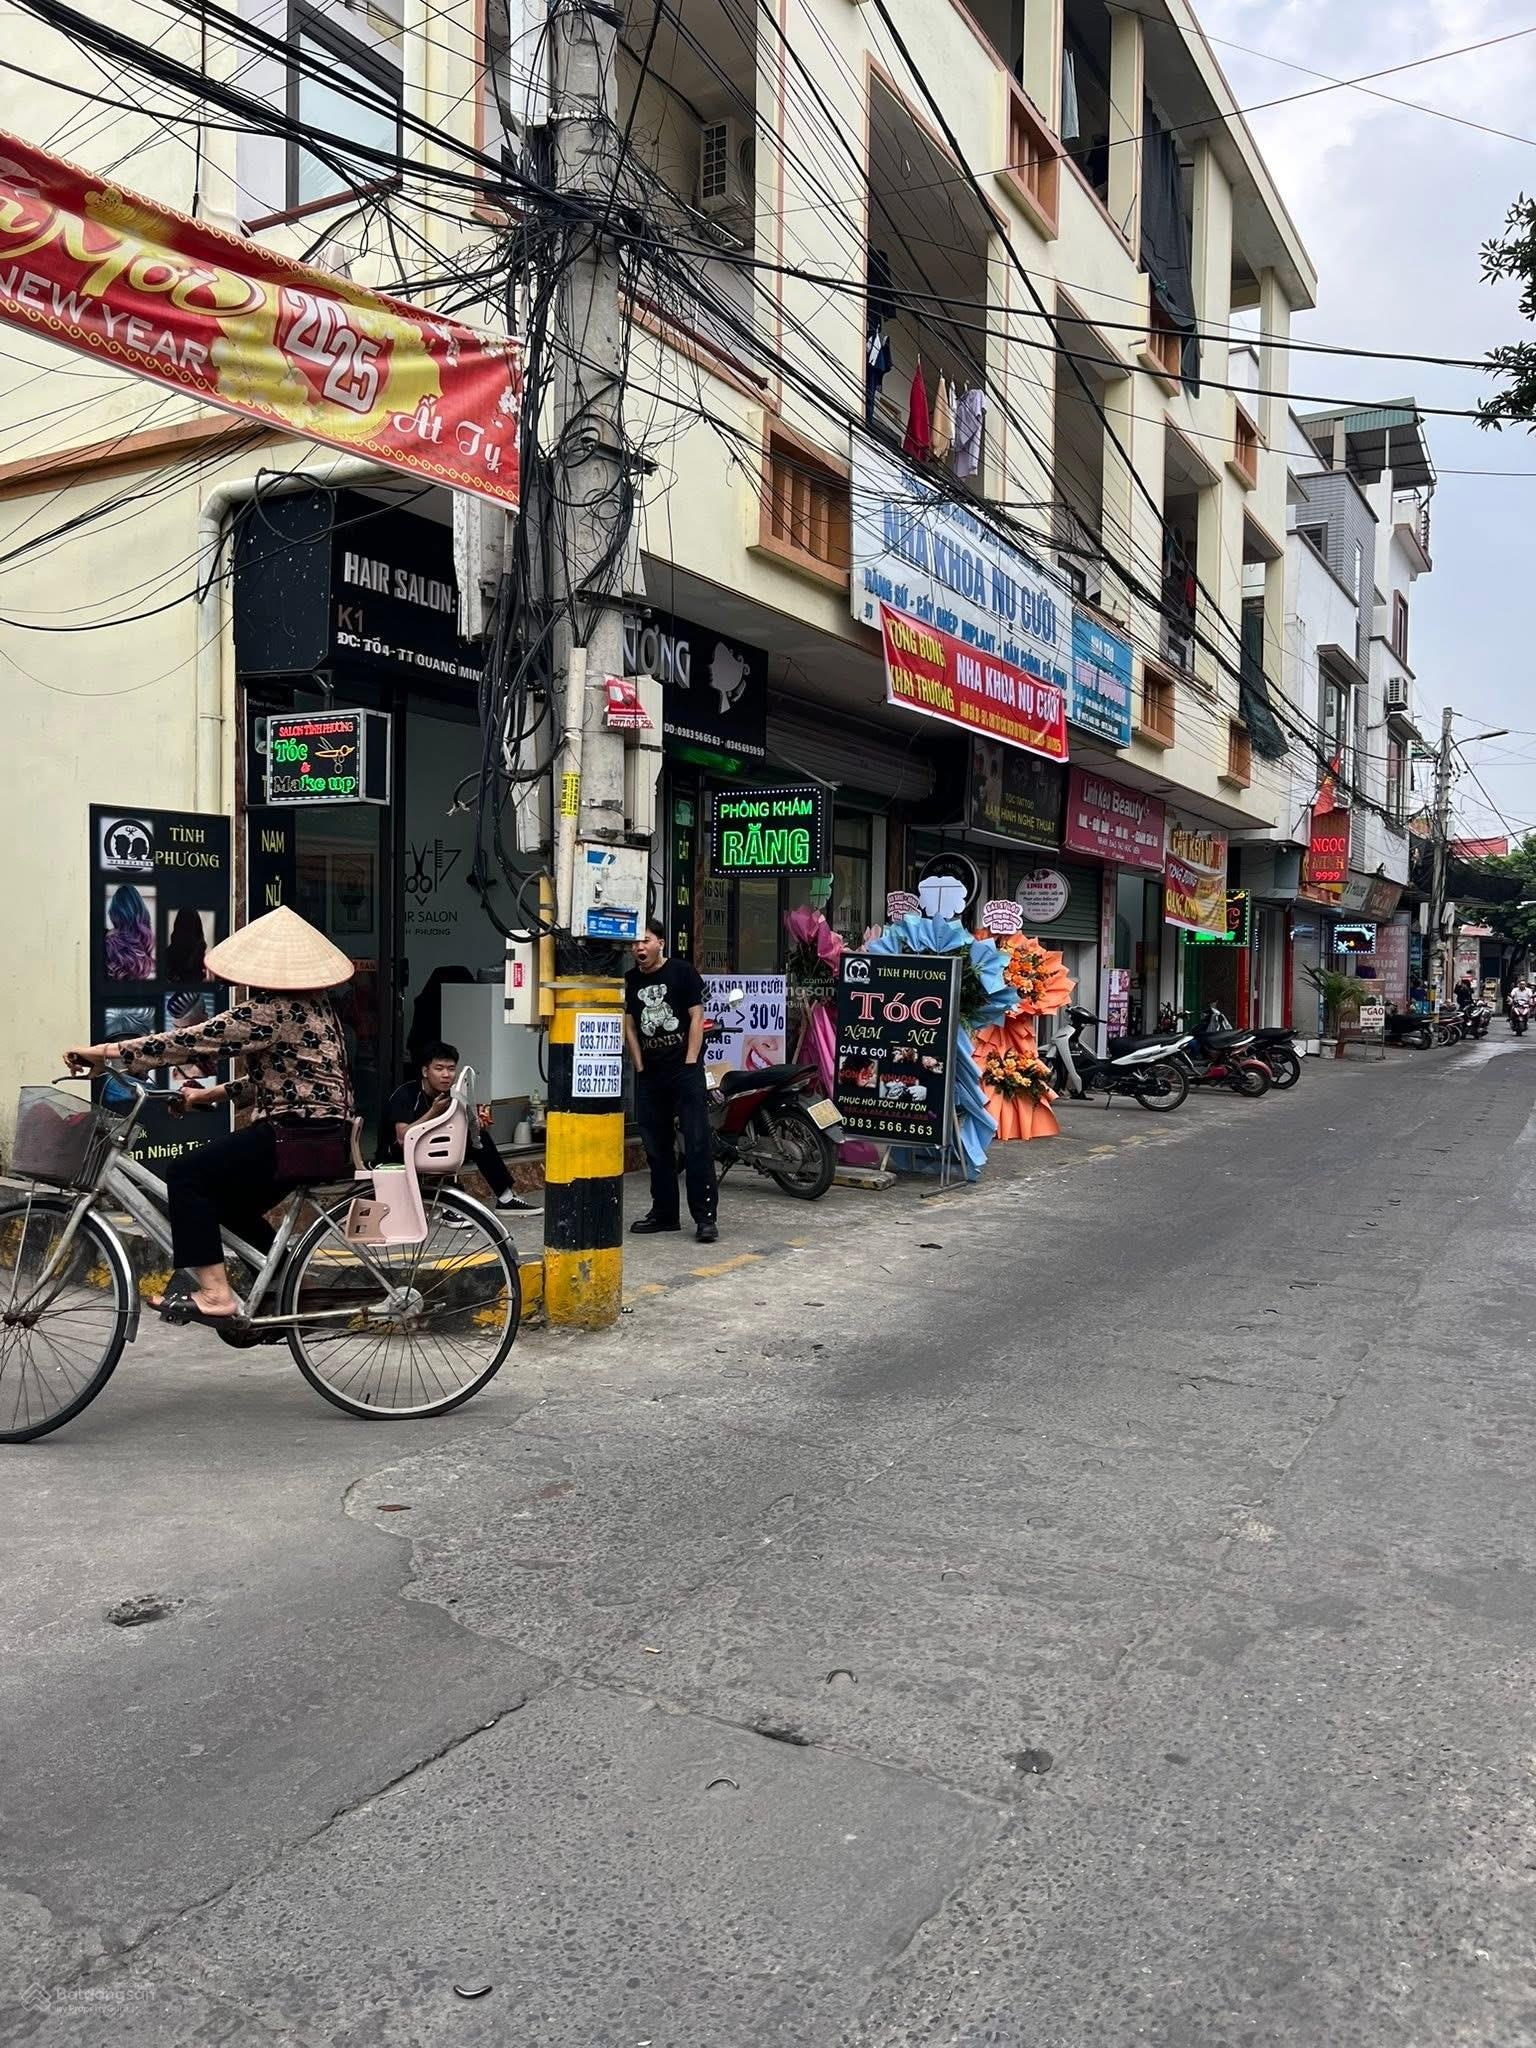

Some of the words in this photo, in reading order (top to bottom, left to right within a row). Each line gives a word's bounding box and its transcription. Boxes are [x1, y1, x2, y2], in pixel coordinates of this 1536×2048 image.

[102, 304, 208, 376] YEAR
[284, 287, 381, 412] 2025
[393, 395, 443, 444] Ất
[344, 551, 390, 594] HAIR
[934, 531, 985, 606] KHOA
[339, 604, 364, 633] K1
[415, 654, 456, 675] QUANG
[458, 666, 483, 681] MIN
[956, 652, 982, 694] NHA
[985, 665, 1015, 707] KHOA
[1018, 680, 1034, 720] NỤ
[273, 775, 326, 793] Make
[328, 776, 355, 794] up
[720, 799, 770, 819] PHÒNG
[773, 796, 813, 816] KHÁM
[1112, 790, 1145, 826] Beauty
[169, 823, 205, 844] TÌNH
[261, 829, 285, 853] NAM
[723, 822, 810, 866] RĂNG
[155, 850, 220, 869] PHƯƠNG
[1315, 871, 1340, 881] 9999
[418, 911, 458, 923] SALON
[877, 966, 900, 978] TÌNH
[902, 968, 947, 981] PHƯƠNG
[761, 978, 783, 994] CƯỜI
[580, 1021, 595, 1033] CHO
[597, 1021, 609, 1033] VAY
[845, 1024, 884, 1041] NAM
[861, 1047, 867, 1056] &
[577, 1064, 592, 1076] CHO
[594, 1064, 607, 1076] VAY
[840, 1116, 934, 1136] 0983.566.563
[148, 1143, 183, 1159] Nhiệt
